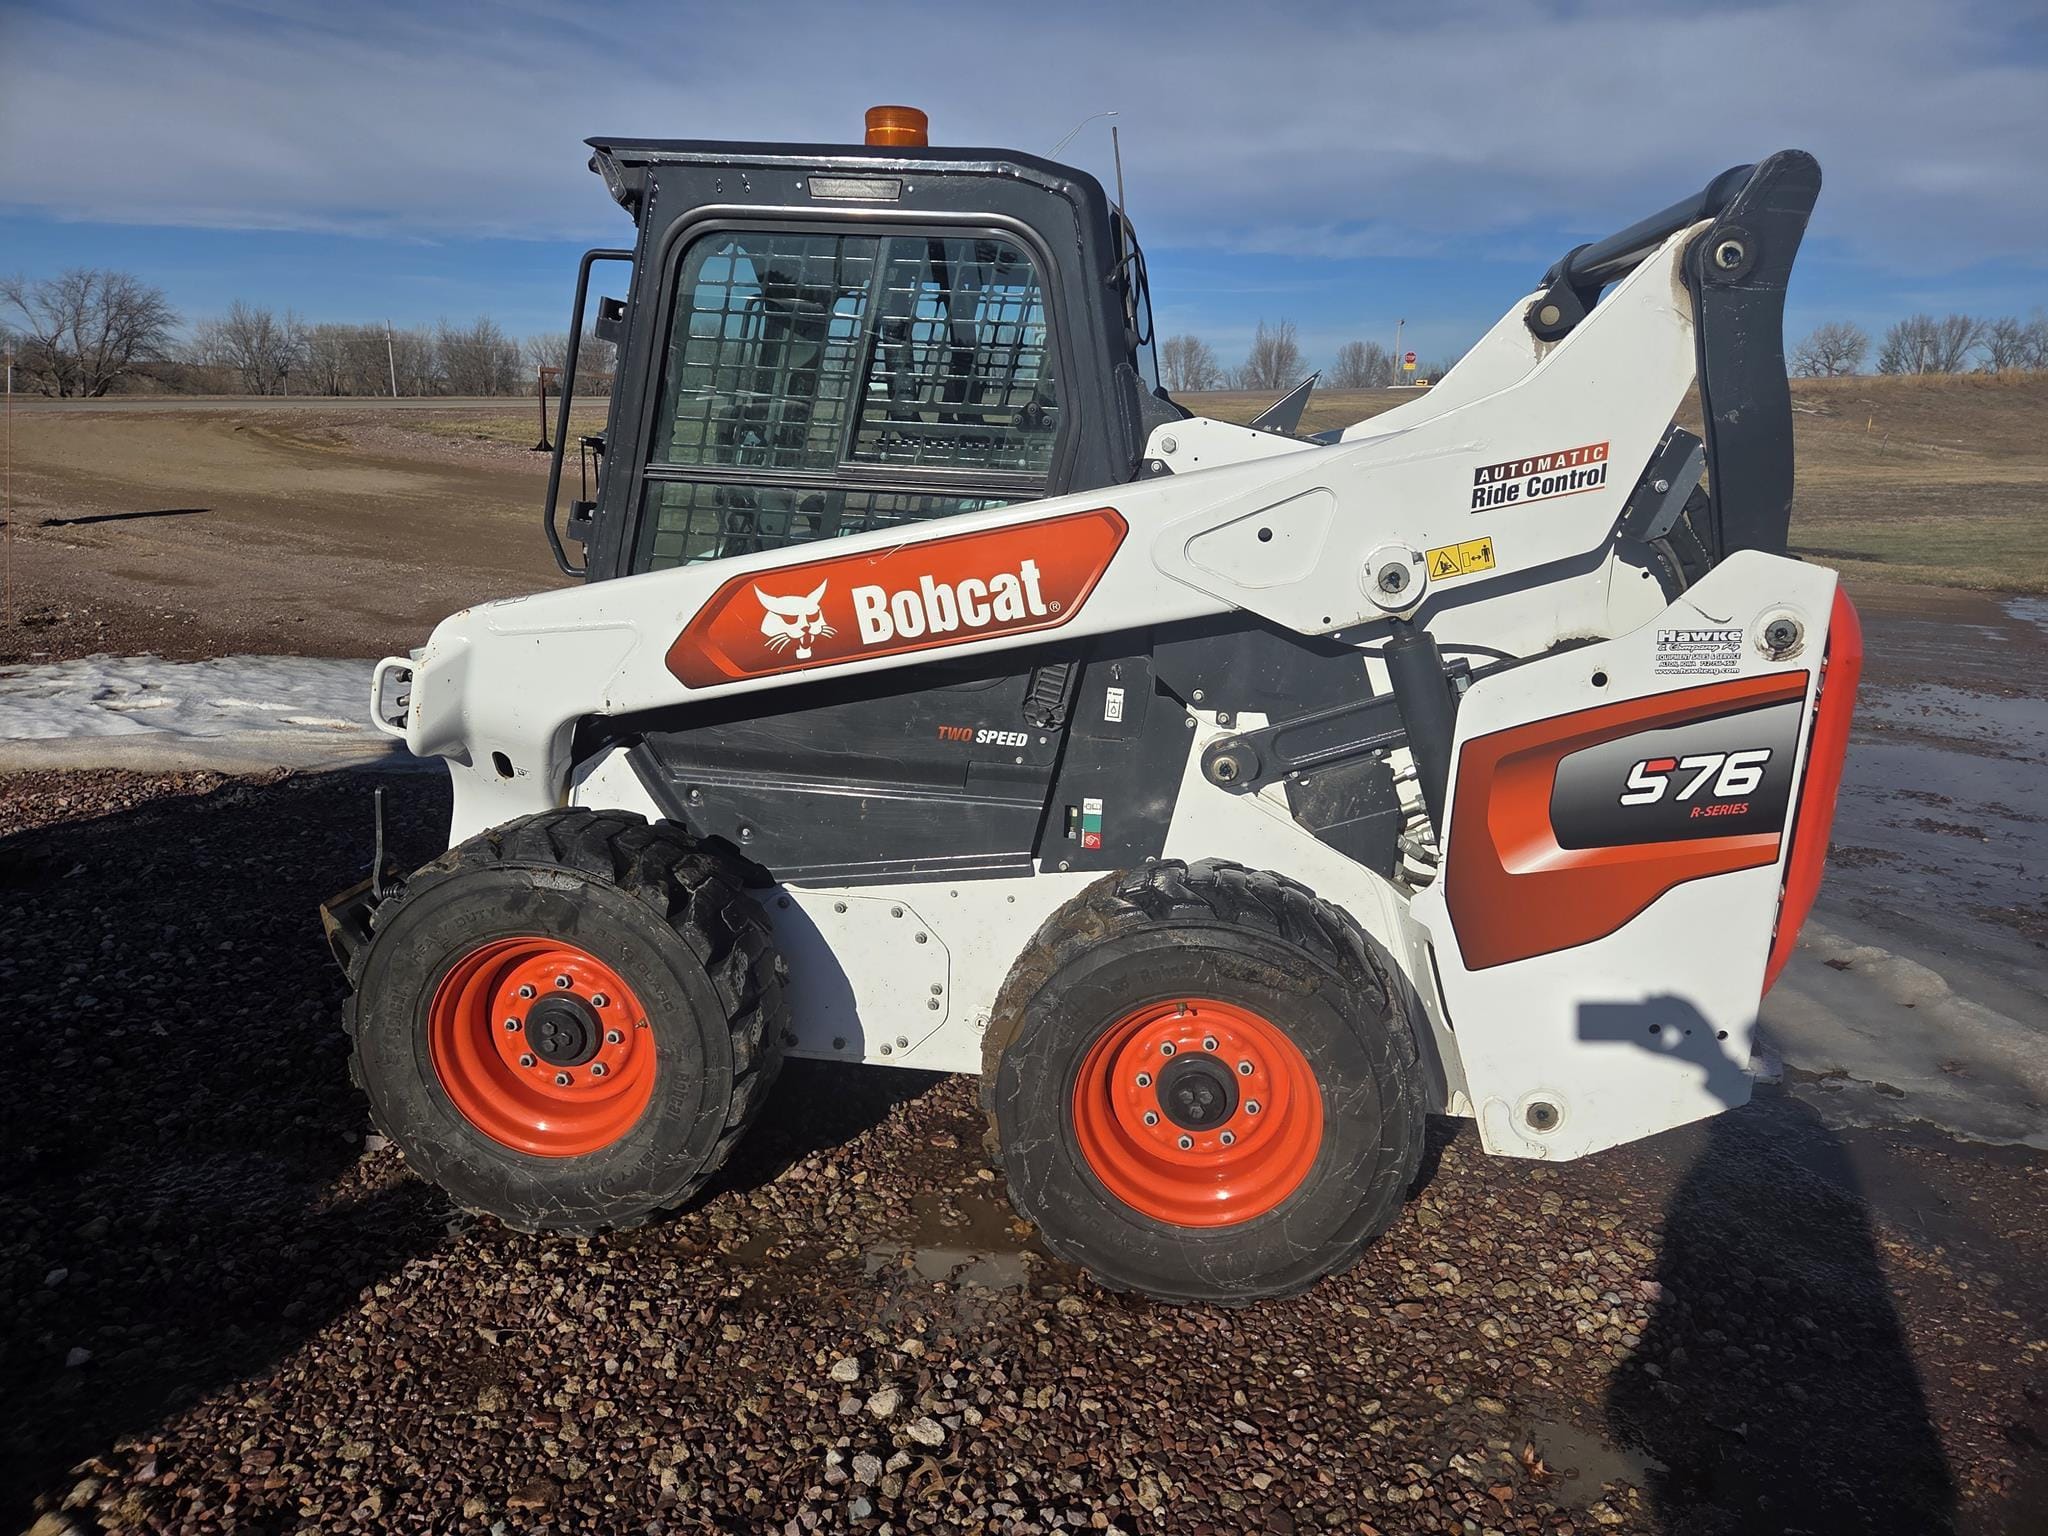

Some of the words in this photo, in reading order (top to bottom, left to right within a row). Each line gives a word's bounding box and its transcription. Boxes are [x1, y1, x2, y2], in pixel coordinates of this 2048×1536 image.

[1479, 446, 1604, 483] AUTOMATIC
[1471, 482, 1520, 508] Ride
[1526, 462, 1607, 497] Control
[1656, 653, 1691, 661] EQUIPMENT
[938, 725, 973, 742] TWO
[975, 729, 1029, 747] SPEED
[1619, 749, 1772, 806] S76
[1689, 802, 1750, 818] R-SERIES
